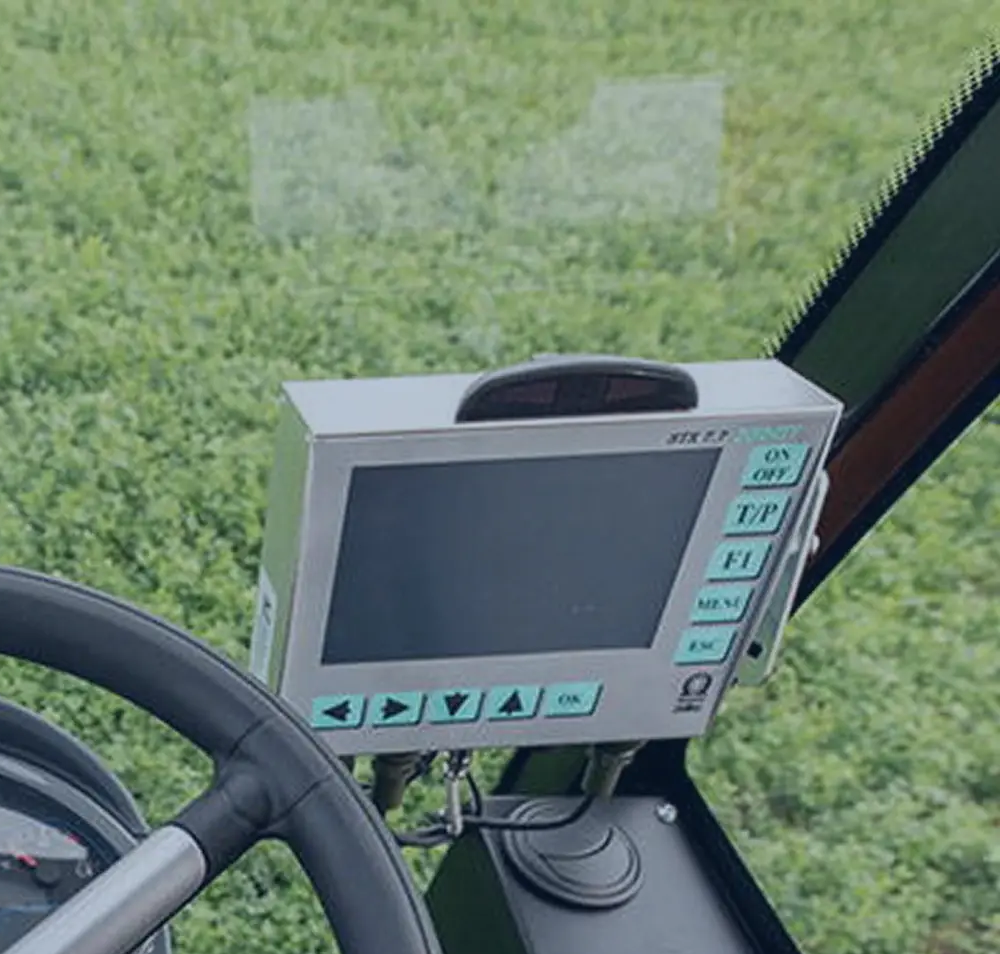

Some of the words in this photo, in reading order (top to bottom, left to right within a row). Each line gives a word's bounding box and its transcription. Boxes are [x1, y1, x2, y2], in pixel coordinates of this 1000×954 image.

[764, 447, 790, 464] ON
[752, 466, 791, 481] OFF
[737, 502, 778, 525] T/P
[558, 693, 582, 707] OK
